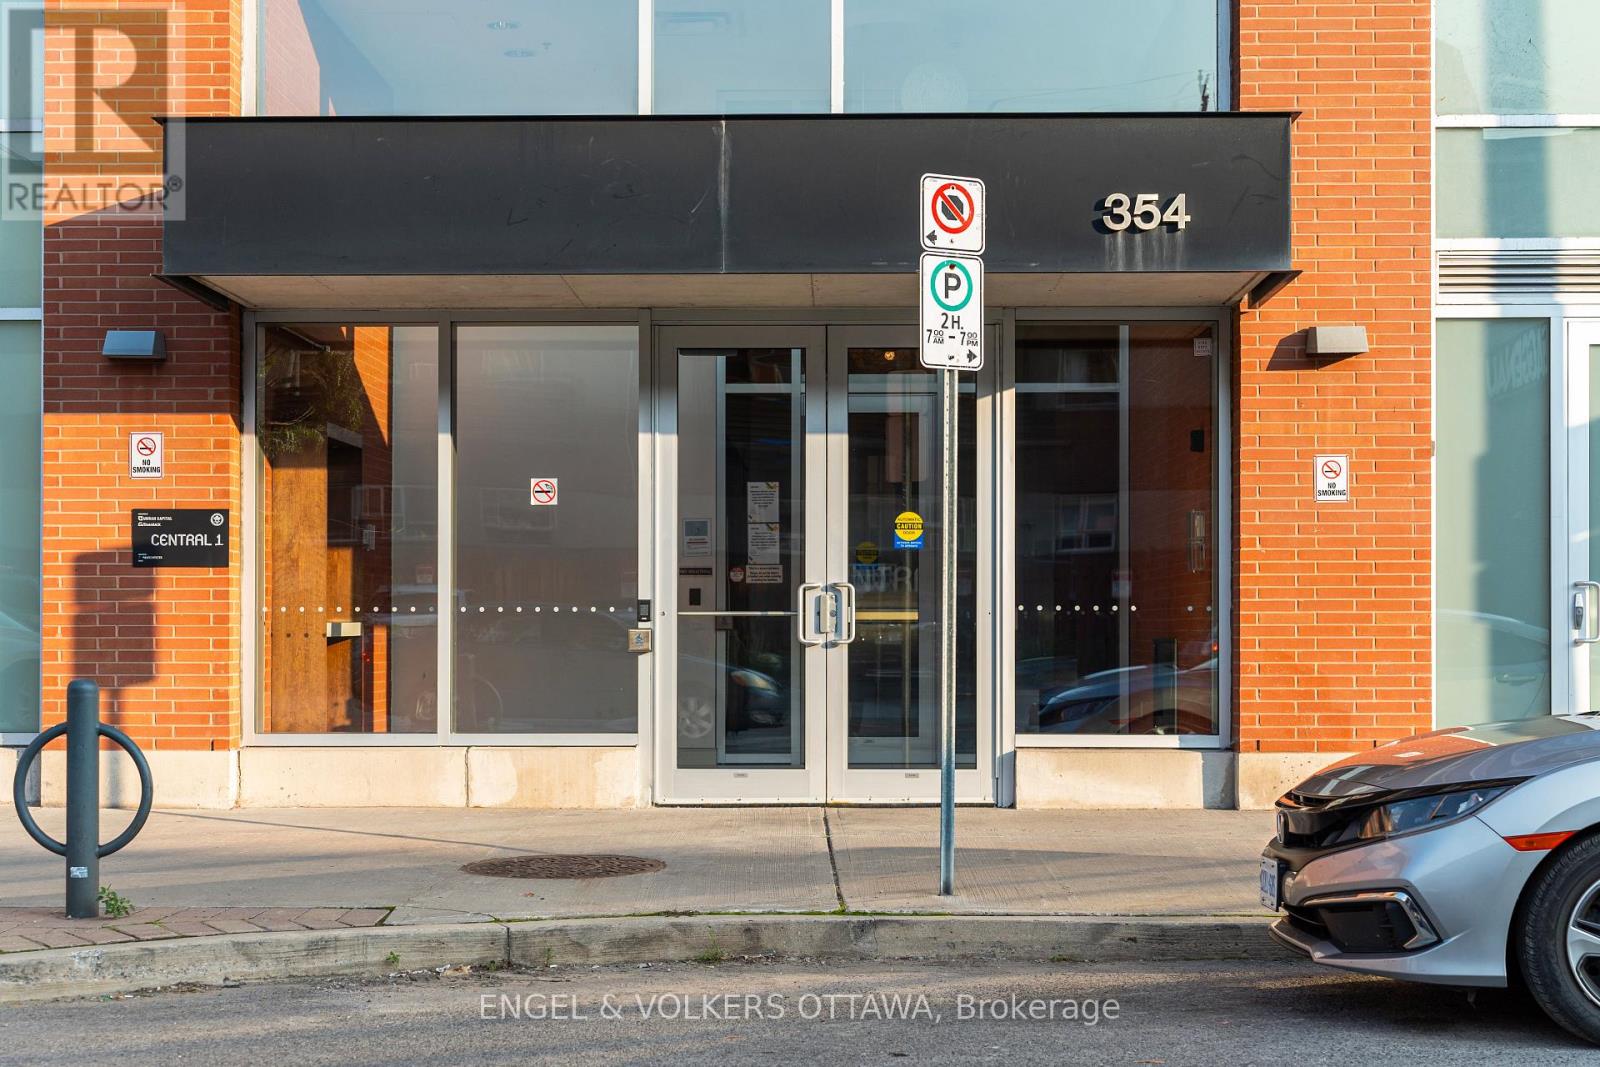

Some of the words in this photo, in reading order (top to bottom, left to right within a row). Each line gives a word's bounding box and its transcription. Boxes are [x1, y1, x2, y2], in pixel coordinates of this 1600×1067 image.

[1102, 192, 1192, 231] 354
[944, 272, 962, 299] P
[941, 312, 949, 330] 2
[132, 466, 161, 474] SMOKING
[1317, 489, 1347, 497] SMOKING
[150, 533, 213, 547] CENTRAL
[214, 533, 225, 546] 1
